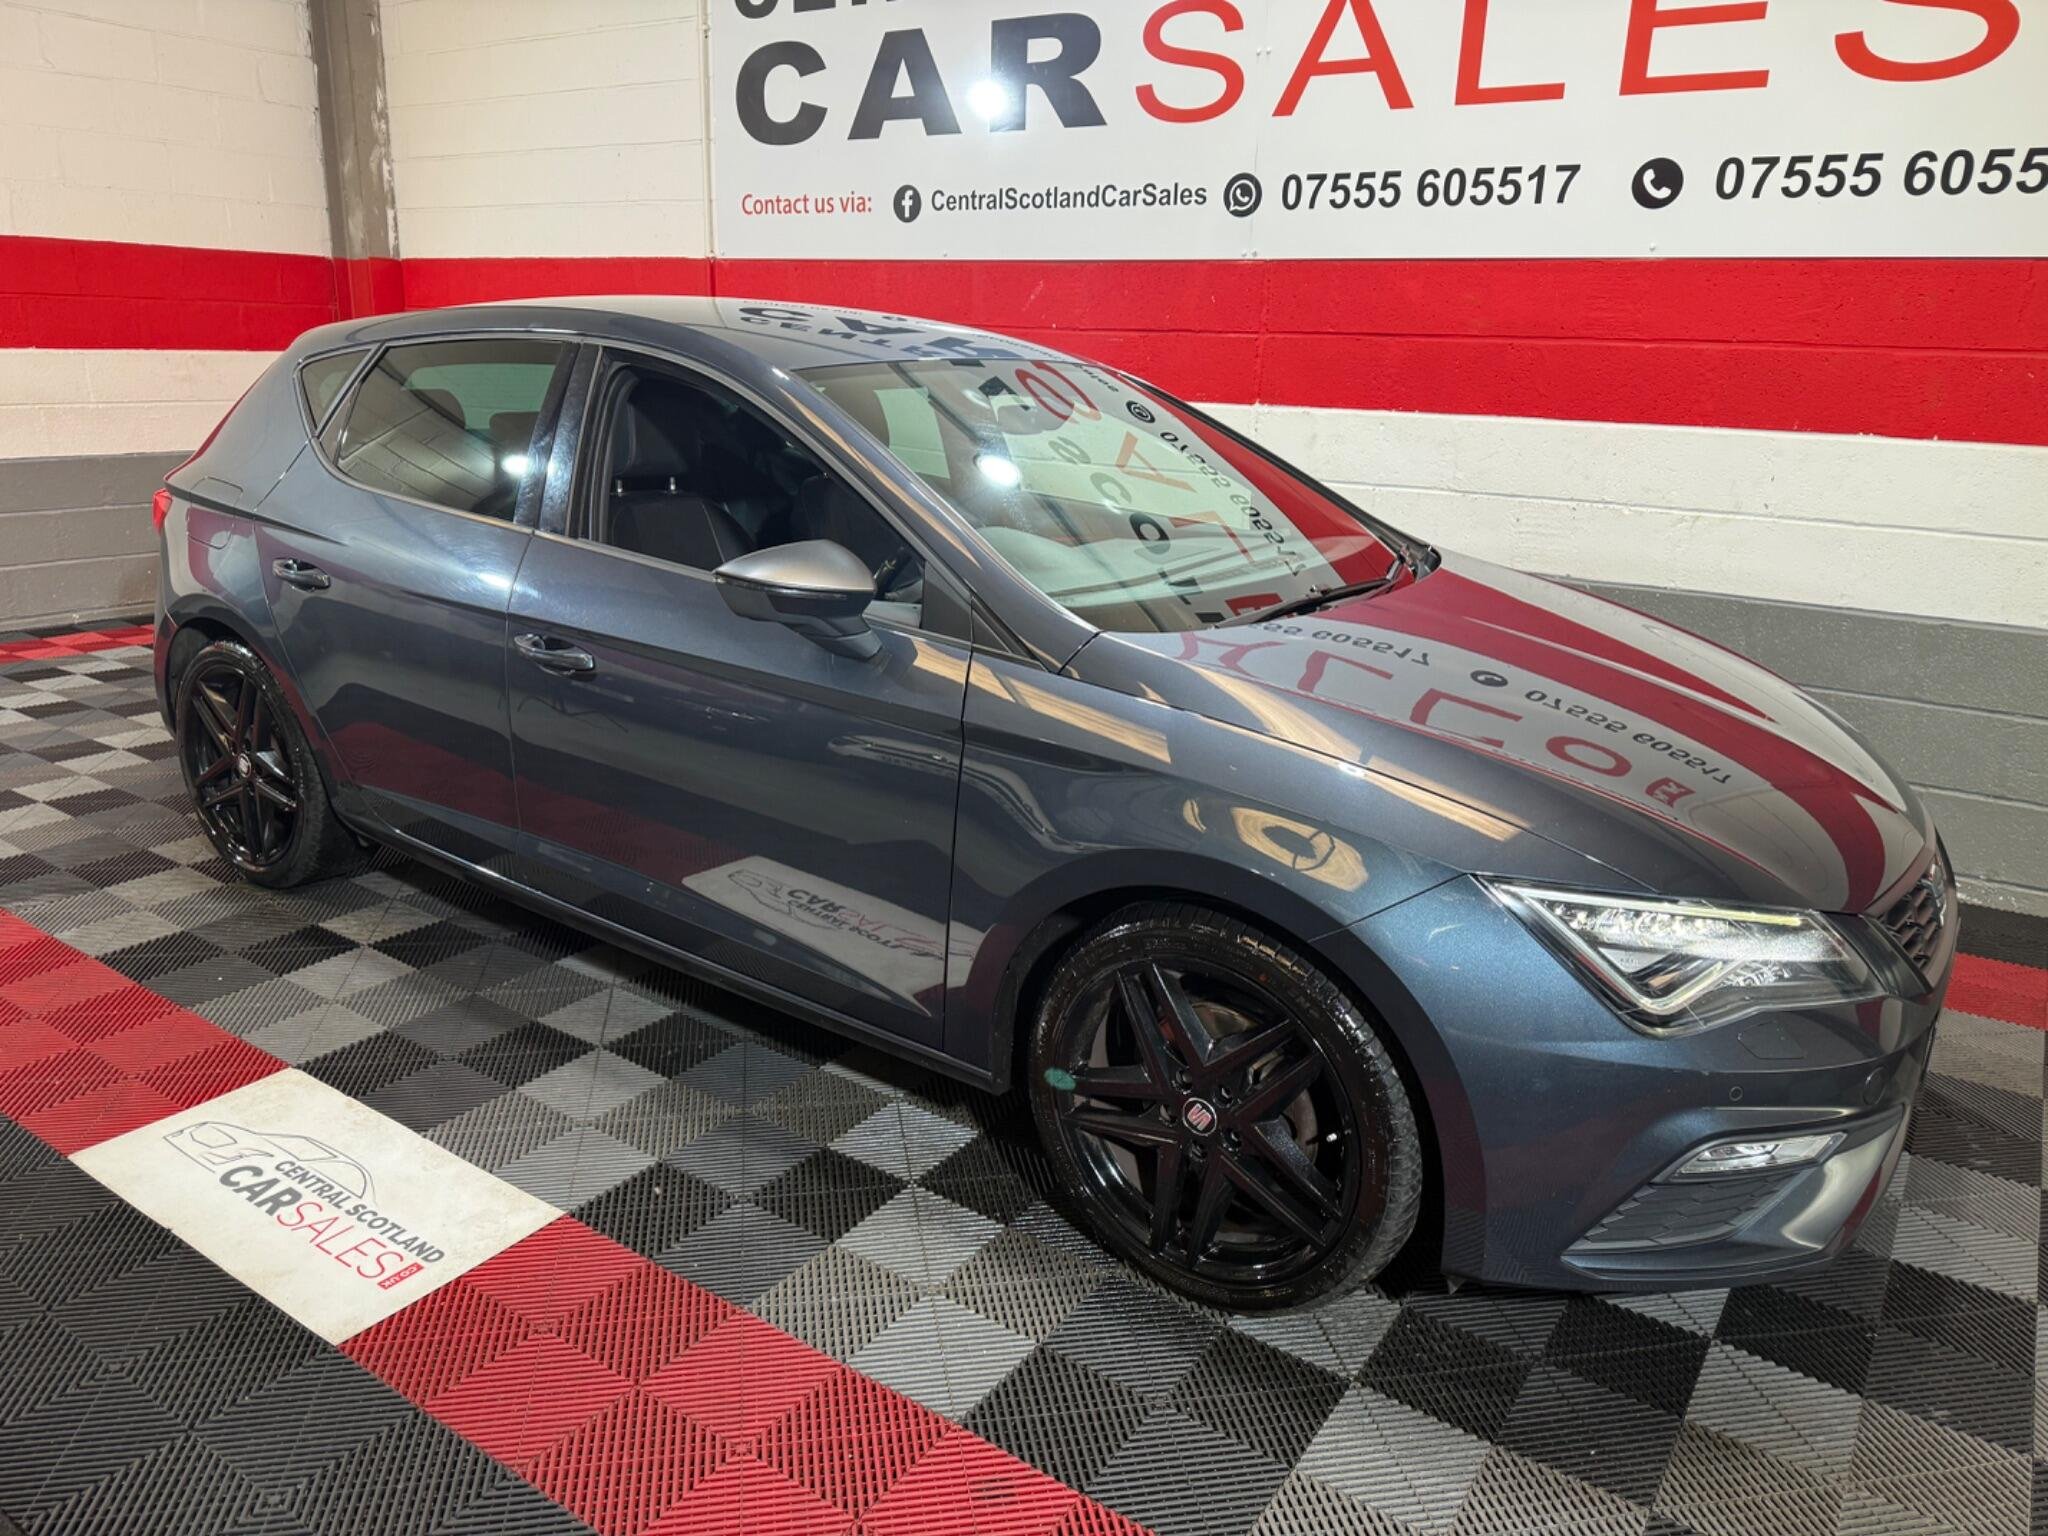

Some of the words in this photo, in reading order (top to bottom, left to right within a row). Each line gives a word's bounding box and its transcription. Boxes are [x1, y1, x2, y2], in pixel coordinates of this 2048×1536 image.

[741, 193, 810, 216] Contact
[815, 195, 835, 214] us
[840, 190, 873, 214] via:
[931, 183, 1208, 213] CentralScotlandCarSales
[1281, 170, 1402, 210] 07555
[1415, 164, 1582, 208] 605517
[1715, 152, 1884, 200] 07555
[275, 1160, 352, 1210] CENTRAL
[345, 1203, 445, 1264] SCOTLAND
